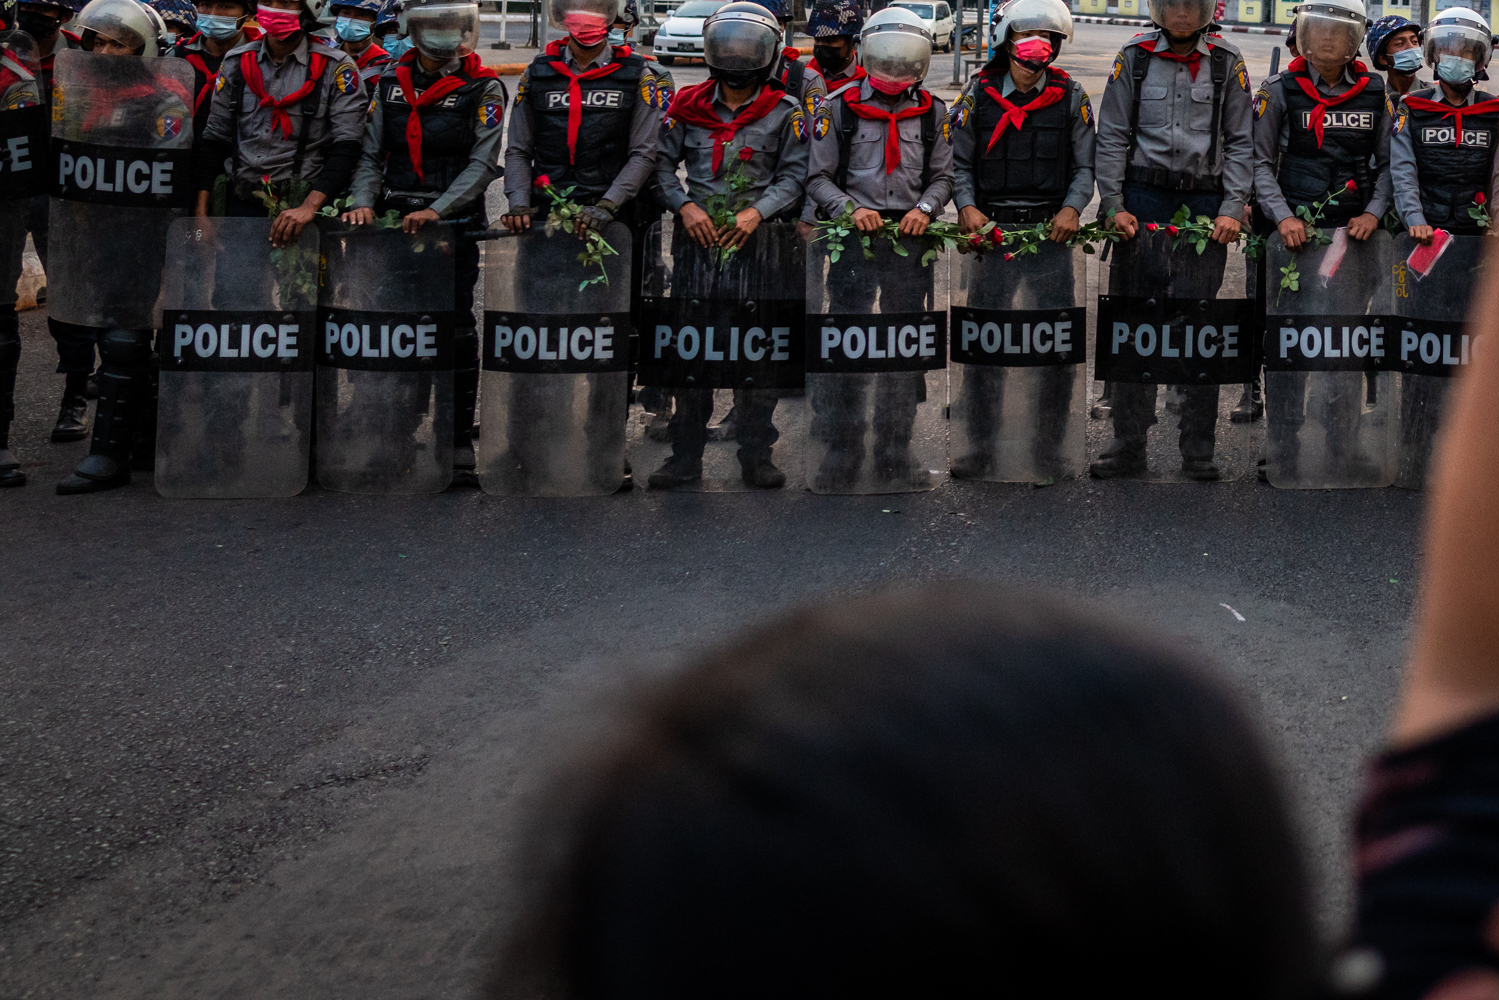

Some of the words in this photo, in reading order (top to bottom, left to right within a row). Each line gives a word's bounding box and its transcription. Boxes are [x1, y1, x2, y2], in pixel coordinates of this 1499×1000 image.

[549, 92, 619, 107] POICE
[60, 153, 173, 193] POLICE
[174, 324, 299, 358] POLICE
[326, 322, 437, 357] POLICE
[495, 325, 614, 360] POLICE
[655, 325, 789, 361] POLICE
[822, 325, 935, 359] POLICE
[962, 321, 1072, 353] POLICE
[1112, 322, 1238, 358] POLICE
[1280, 326, 1384, 358] POLICE
